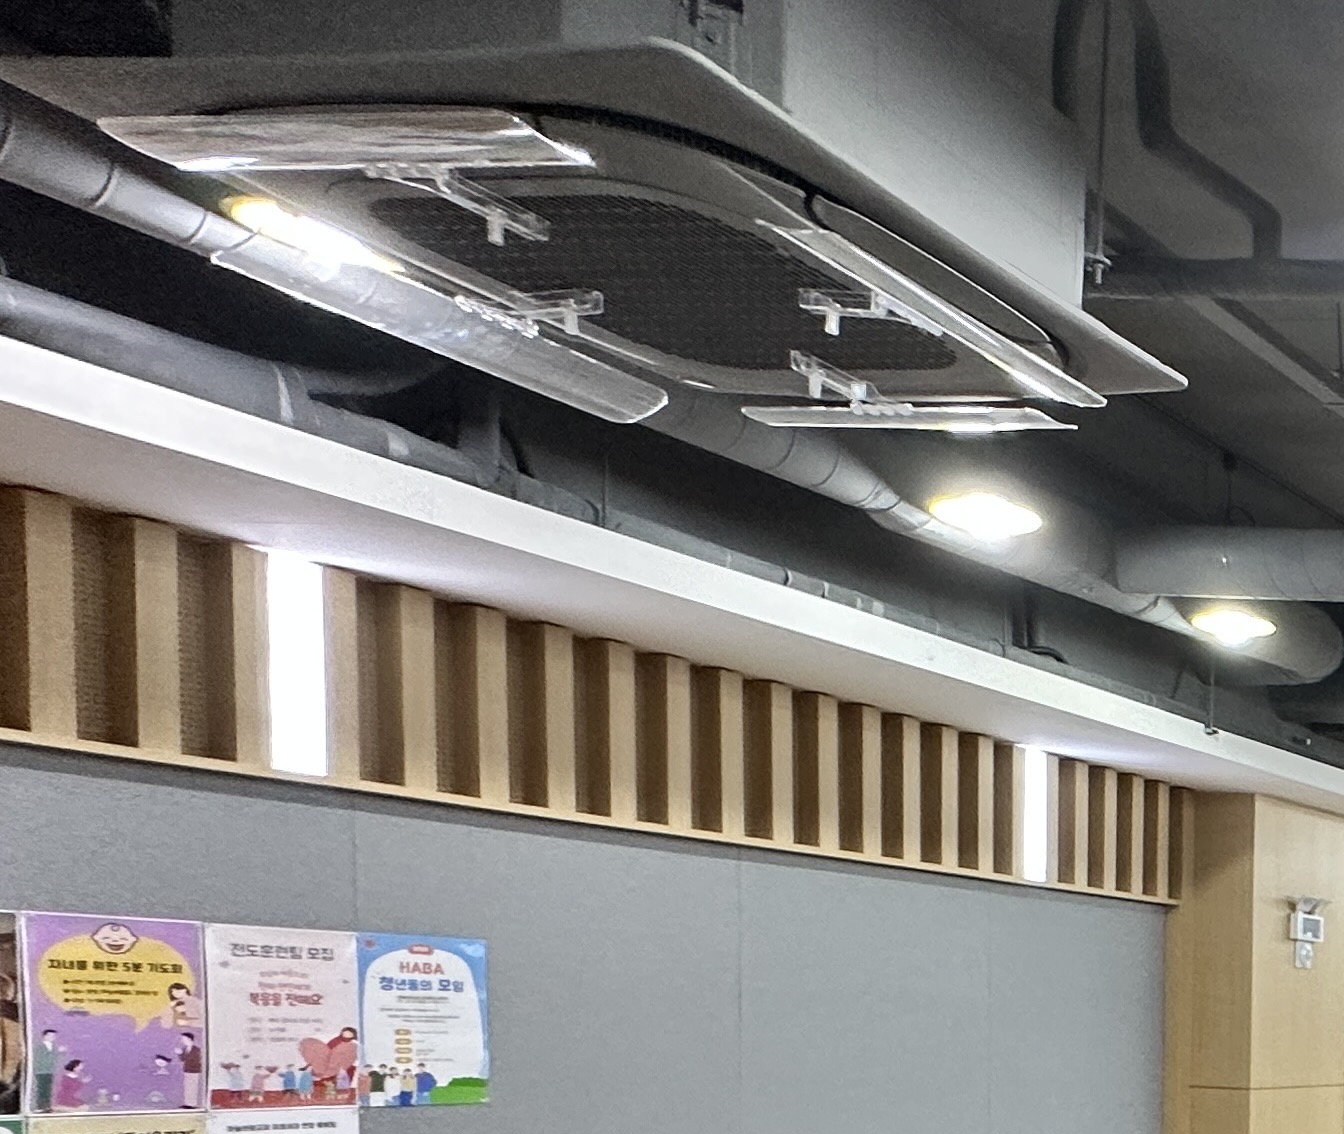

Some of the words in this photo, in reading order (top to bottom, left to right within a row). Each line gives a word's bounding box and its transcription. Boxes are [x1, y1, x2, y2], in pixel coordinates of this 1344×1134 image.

[307, 947, 335, 961] 모집
[399, 961, 445, 976] HABA
[379, 976, 433, 992] 청년들의
[437, 979, 464, 993] 모임
